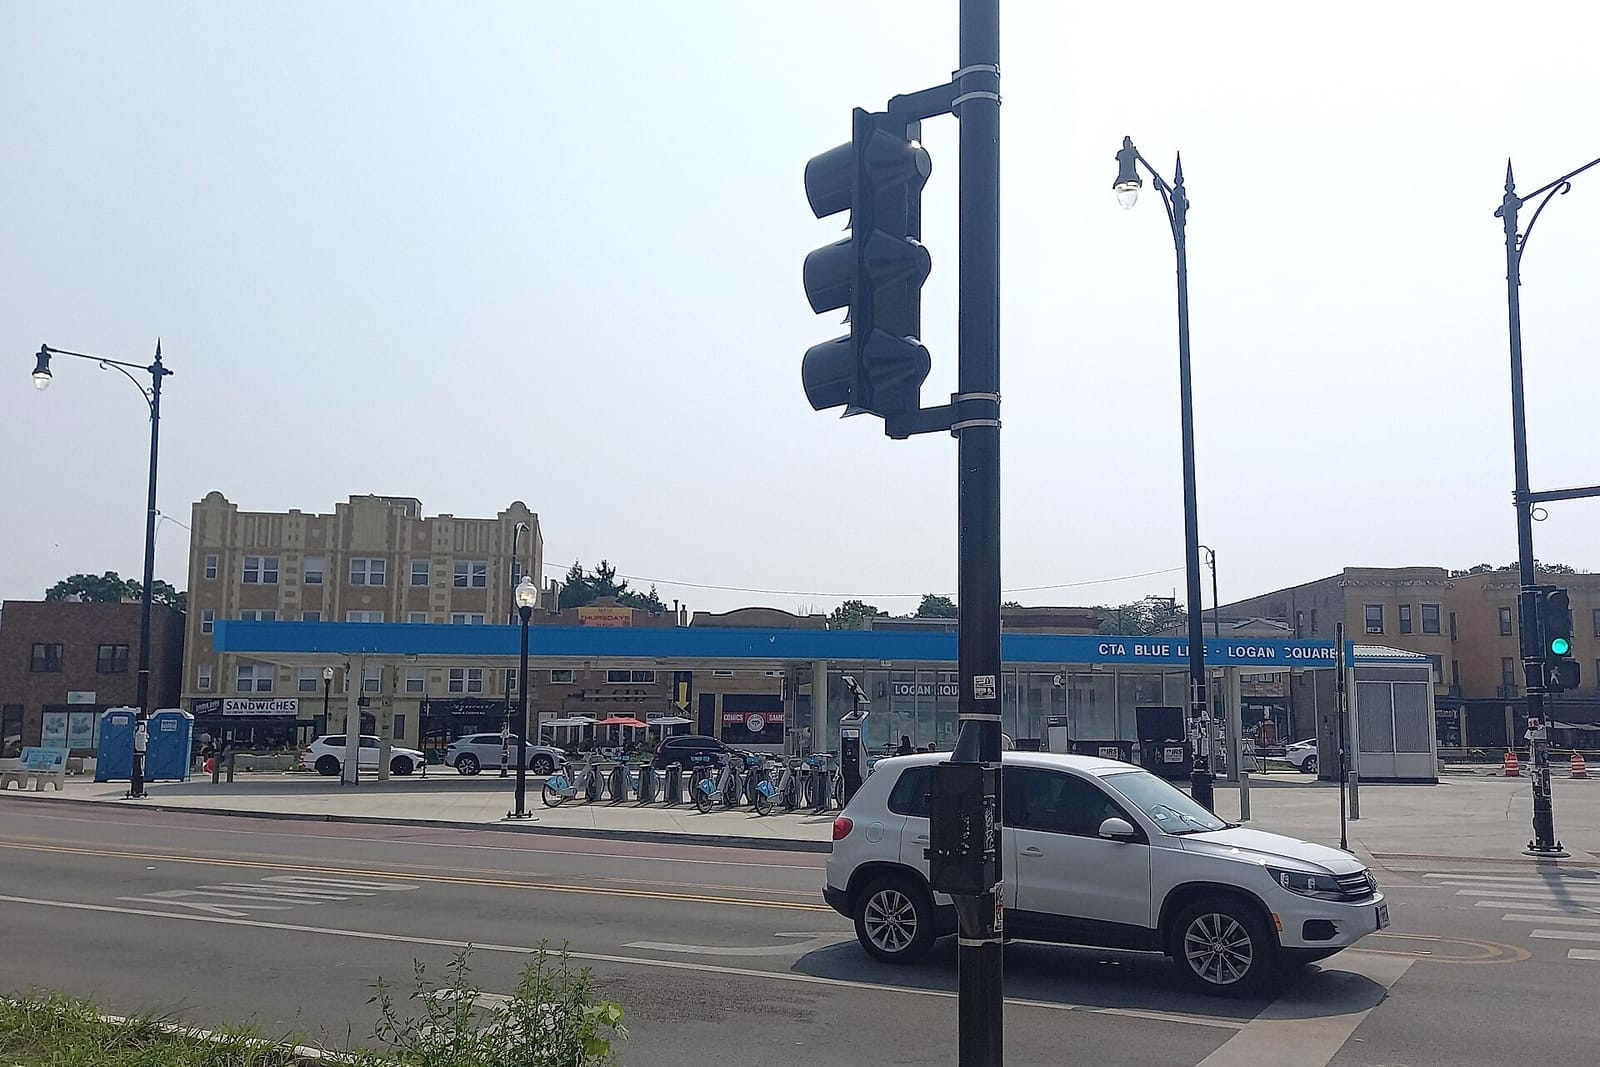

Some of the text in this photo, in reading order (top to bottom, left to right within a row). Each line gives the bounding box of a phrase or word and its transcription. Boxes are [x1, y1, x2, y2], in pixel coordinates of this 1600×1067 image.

[1099, 644, 1126, 655] CTA
[1134, 645, 1170, 656] BLUE
[1178, 645, 1208, 657] LIE
[1228, 646, 1275, 658] LOGAN
[895, 685, 931, 695] LOGAN
[226, 700, 296, 711] SANDWICHES
